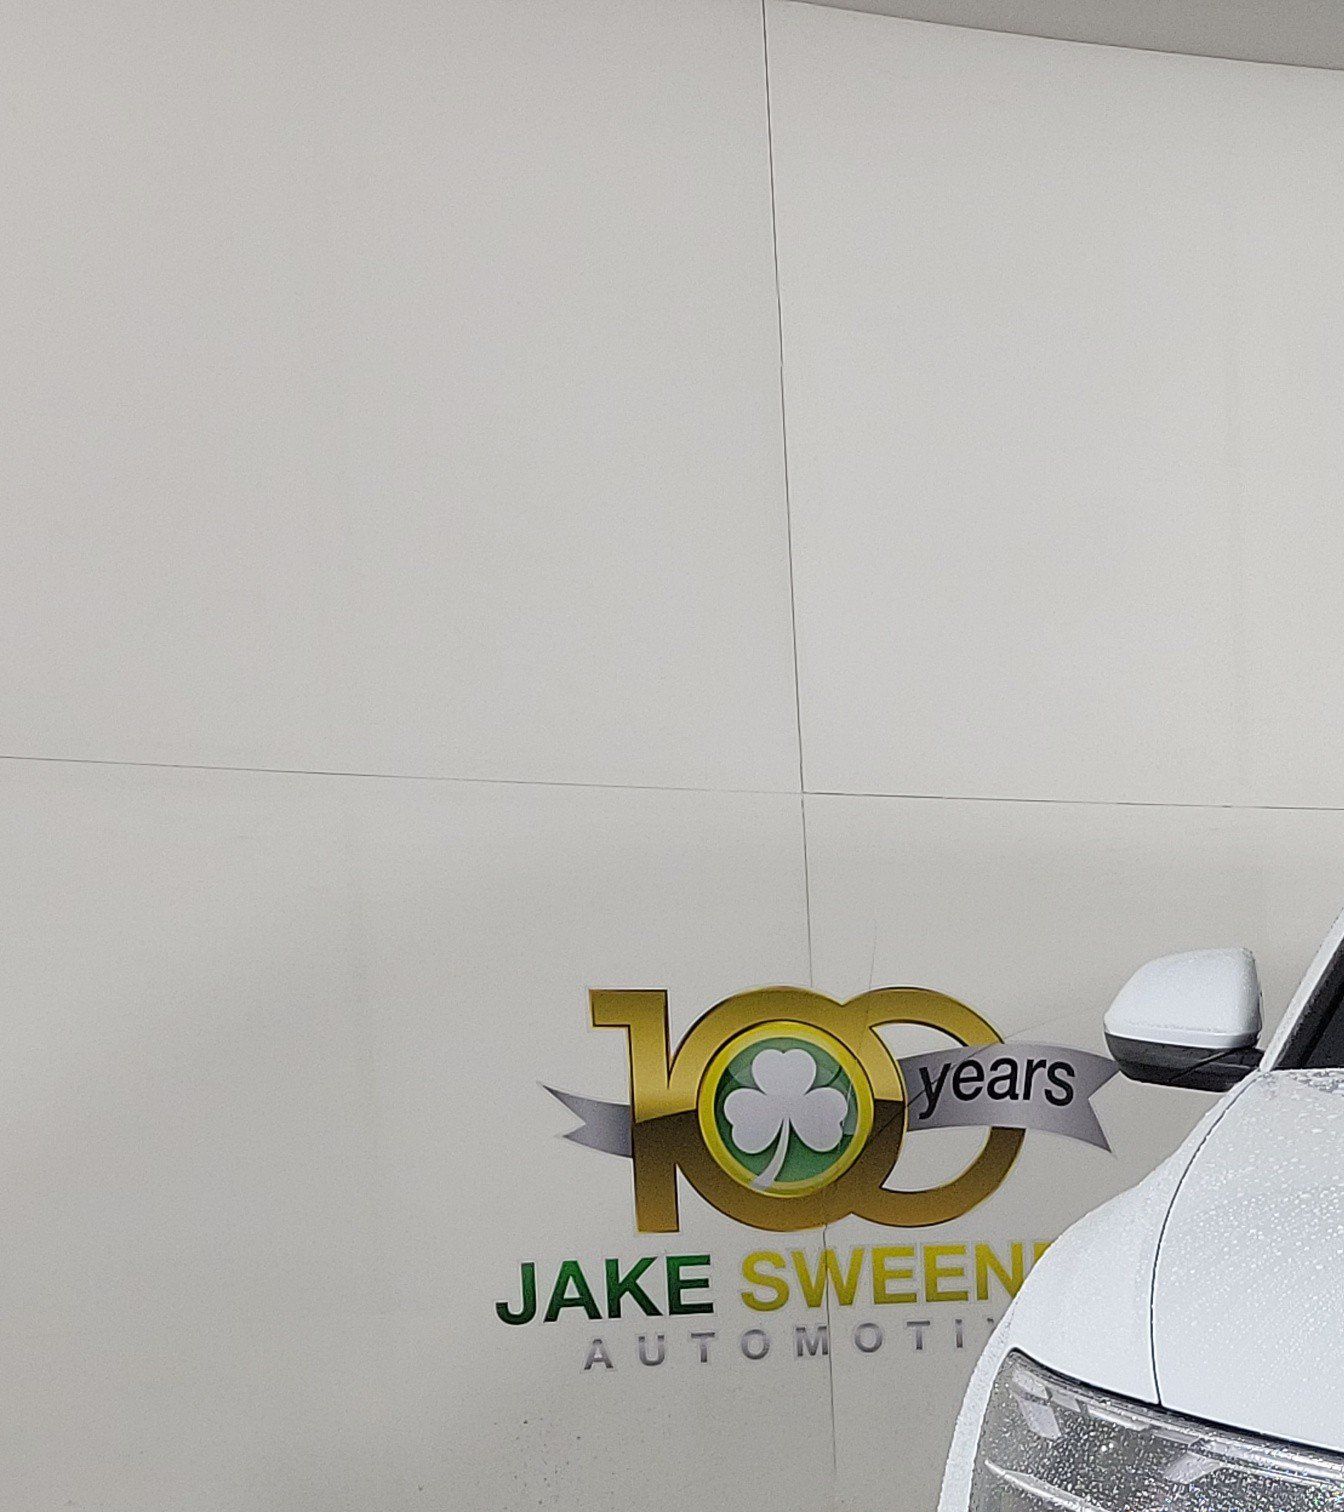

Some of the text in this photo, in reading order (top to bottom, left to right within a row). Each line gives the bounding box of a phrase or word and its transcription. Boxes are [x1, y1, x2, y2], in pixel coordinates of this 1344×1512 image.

[588, 985, 1076, 1233] 100 years
[496, 1241, 1053, 1325] JAKE SWEEN
[584, 1317, 996, 1371] AUTOMOTI
